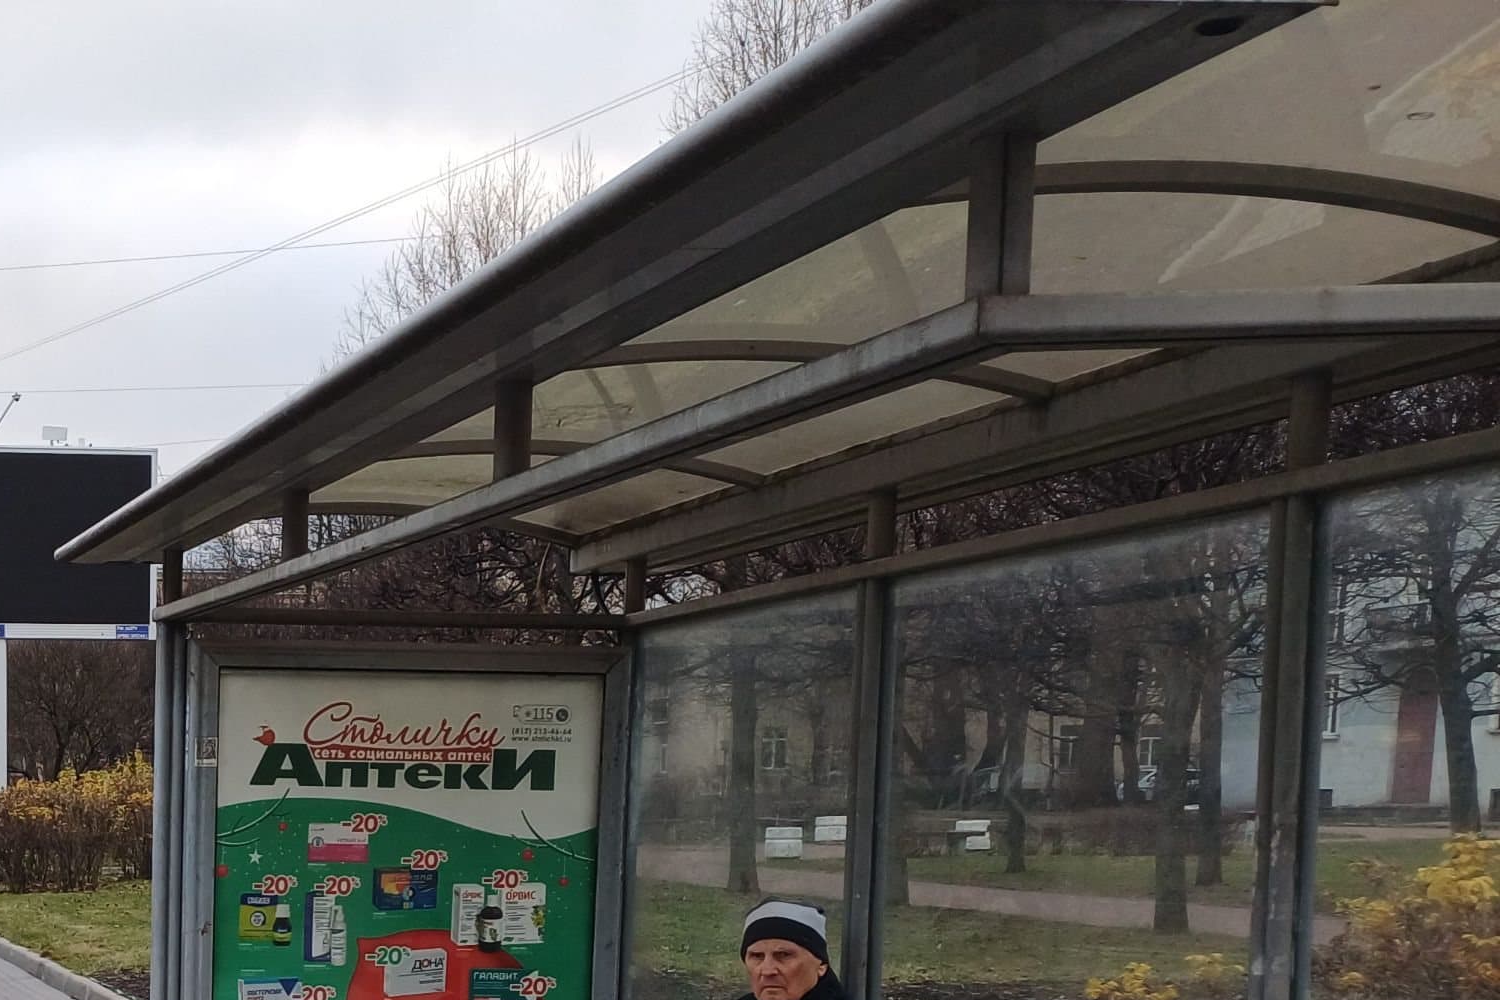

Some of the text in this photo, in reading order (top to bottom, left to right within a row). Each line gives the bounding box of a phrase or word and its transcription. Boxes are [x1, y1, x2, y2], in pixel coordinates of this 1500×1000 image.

[303, 701, 505, 746] Столички
[314, 748, 492, 762] сеть социальных аптек
[412, 957, 444, 972] ДОНА
[473, 972, 519, 981] ГАЛАВИТ
